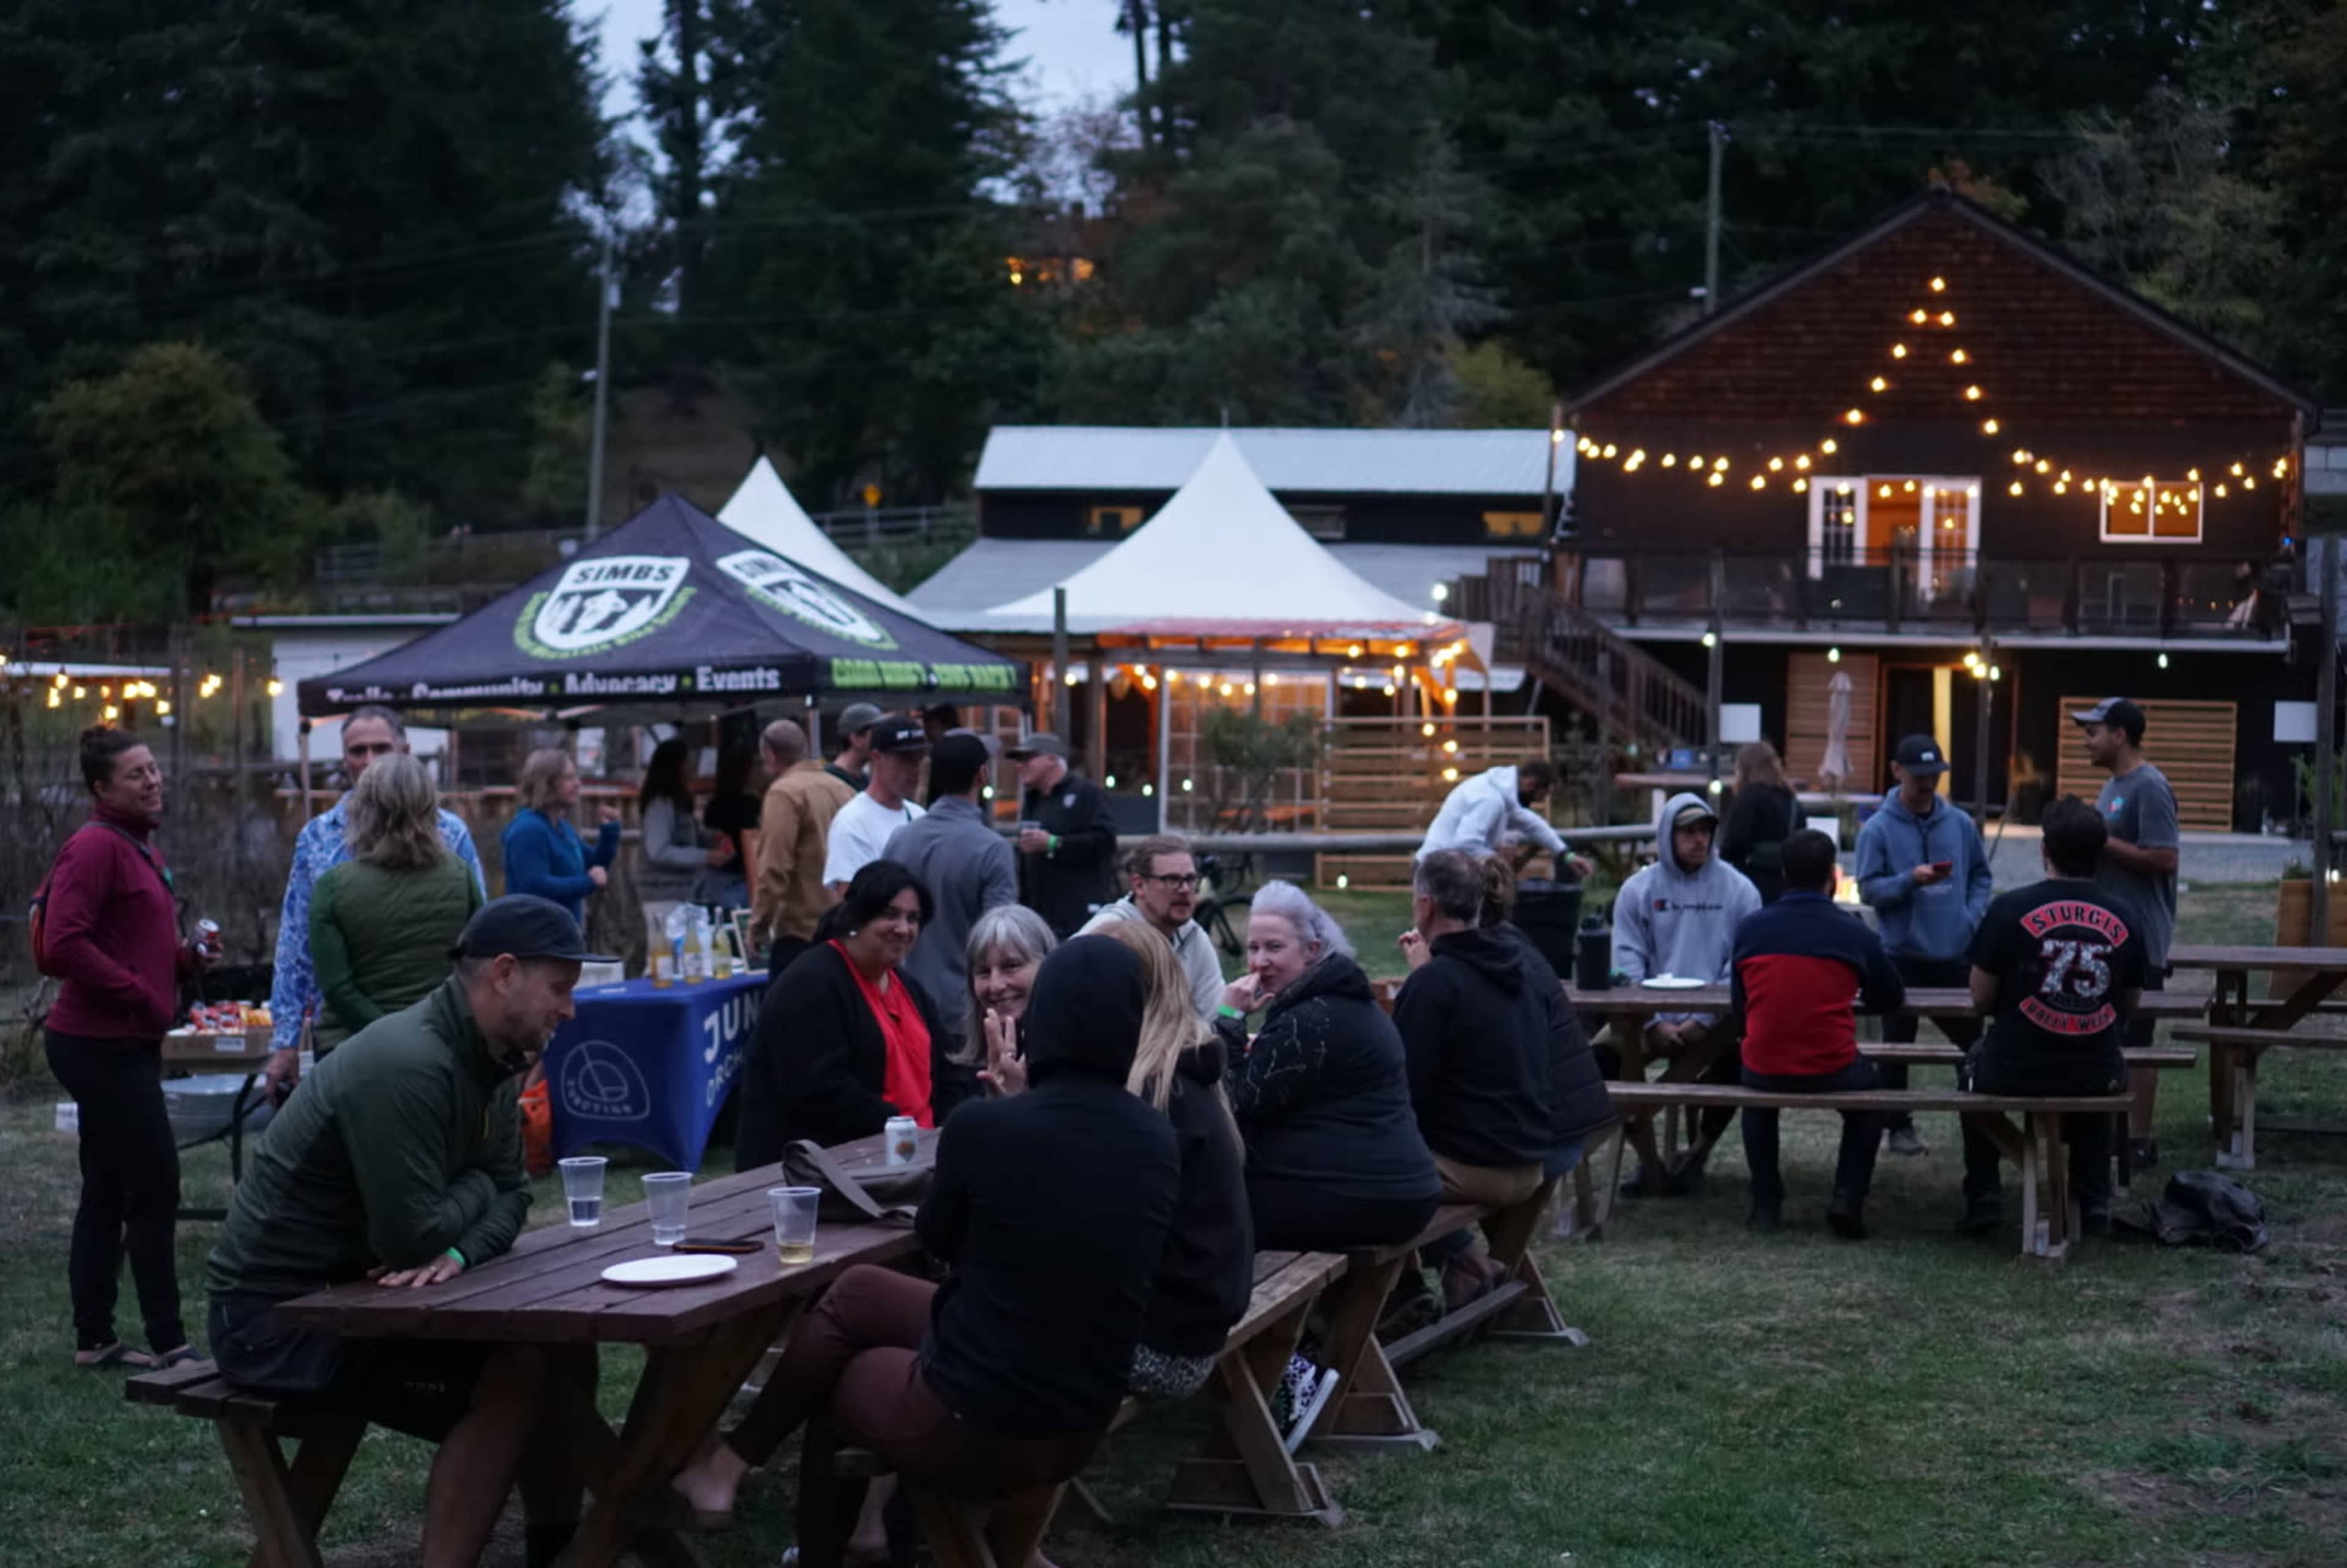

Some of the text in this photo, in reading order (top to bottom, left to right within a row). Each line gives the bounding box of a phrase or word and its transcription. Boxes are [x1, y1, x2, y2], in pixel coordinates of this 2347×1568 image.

[575, 563, 674, 583] SIMBS
[696, 665, 780, 691] Events
[2032, 906, 2121, 938] STURGIS
[2040, 939, 2112, 997] 75
